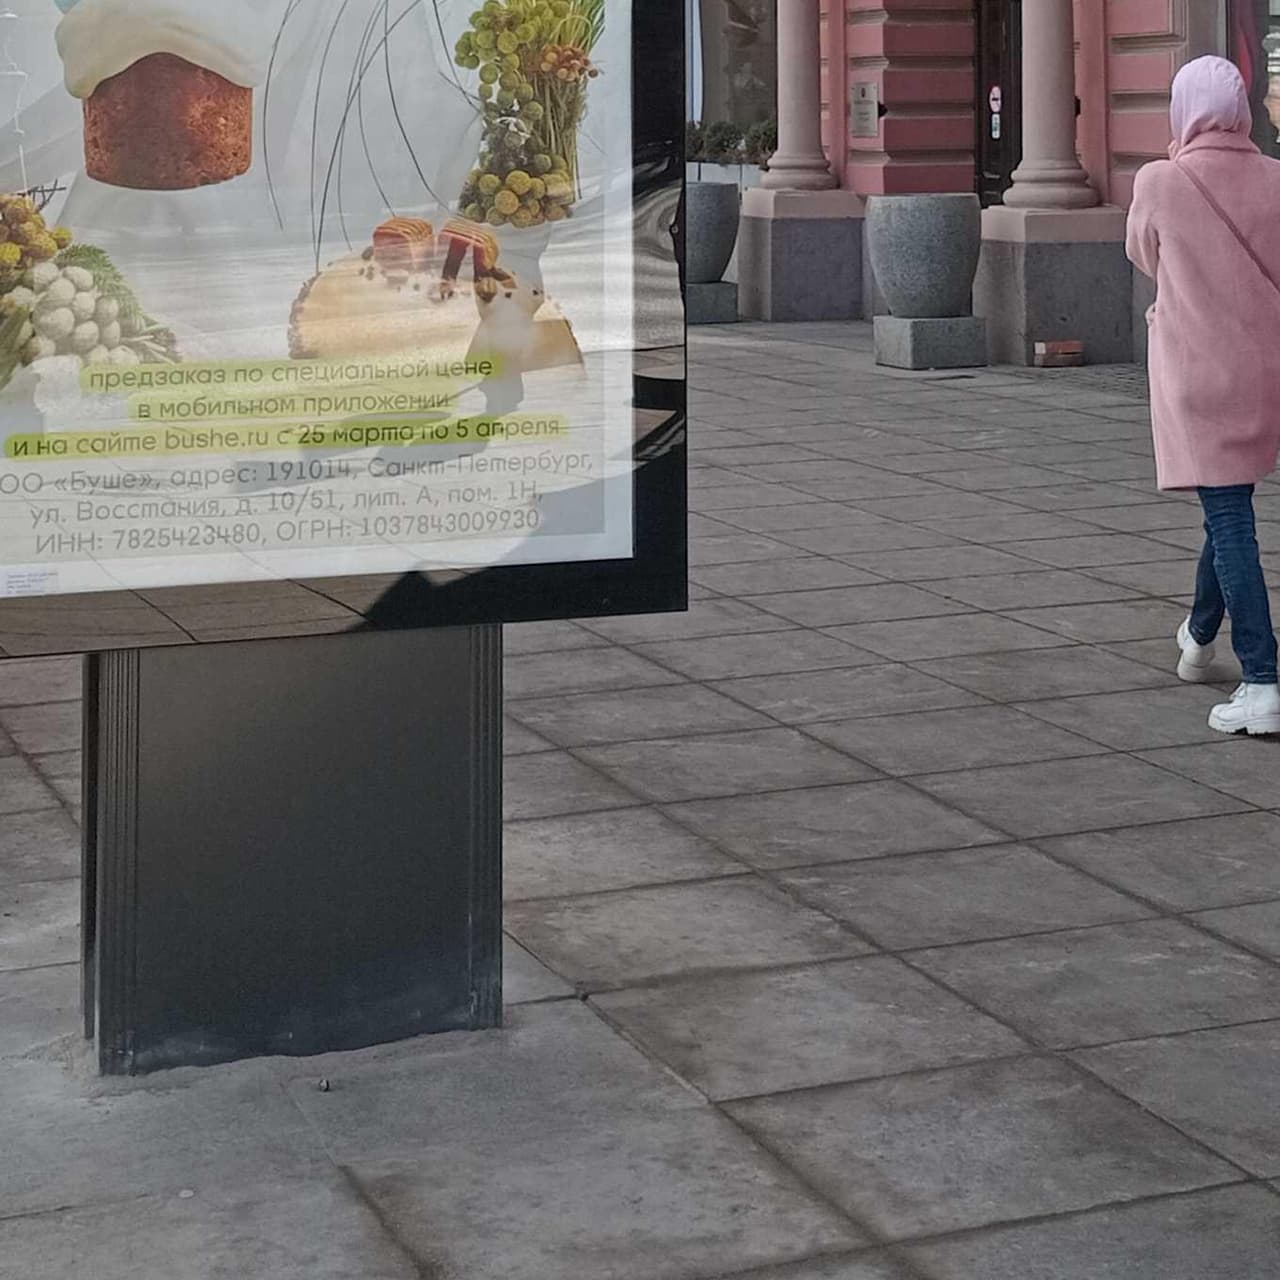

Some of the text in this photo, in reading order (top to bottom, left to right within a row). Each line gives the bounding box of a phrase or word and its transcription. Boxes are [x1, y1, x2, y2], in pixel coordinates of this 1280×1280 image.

[89, 360, 493, 390] предзаказ по специальной цене
[160, 395, 296, 417] мобильном
[302, 392, 450, 414] приложении
[13, 419, 560, 456] и на сайте bushe.ru с 25 марта по 5 апреля
[170, 466, 257, 488] адрес:
[30, 507, 67, 529] ул.
[76, 497, 226, 522] Восстания,
[235, 498, 258, 517] д.
[448, 485, 497, 503] пом.
[36, 532, 103, 555] ИНН:
